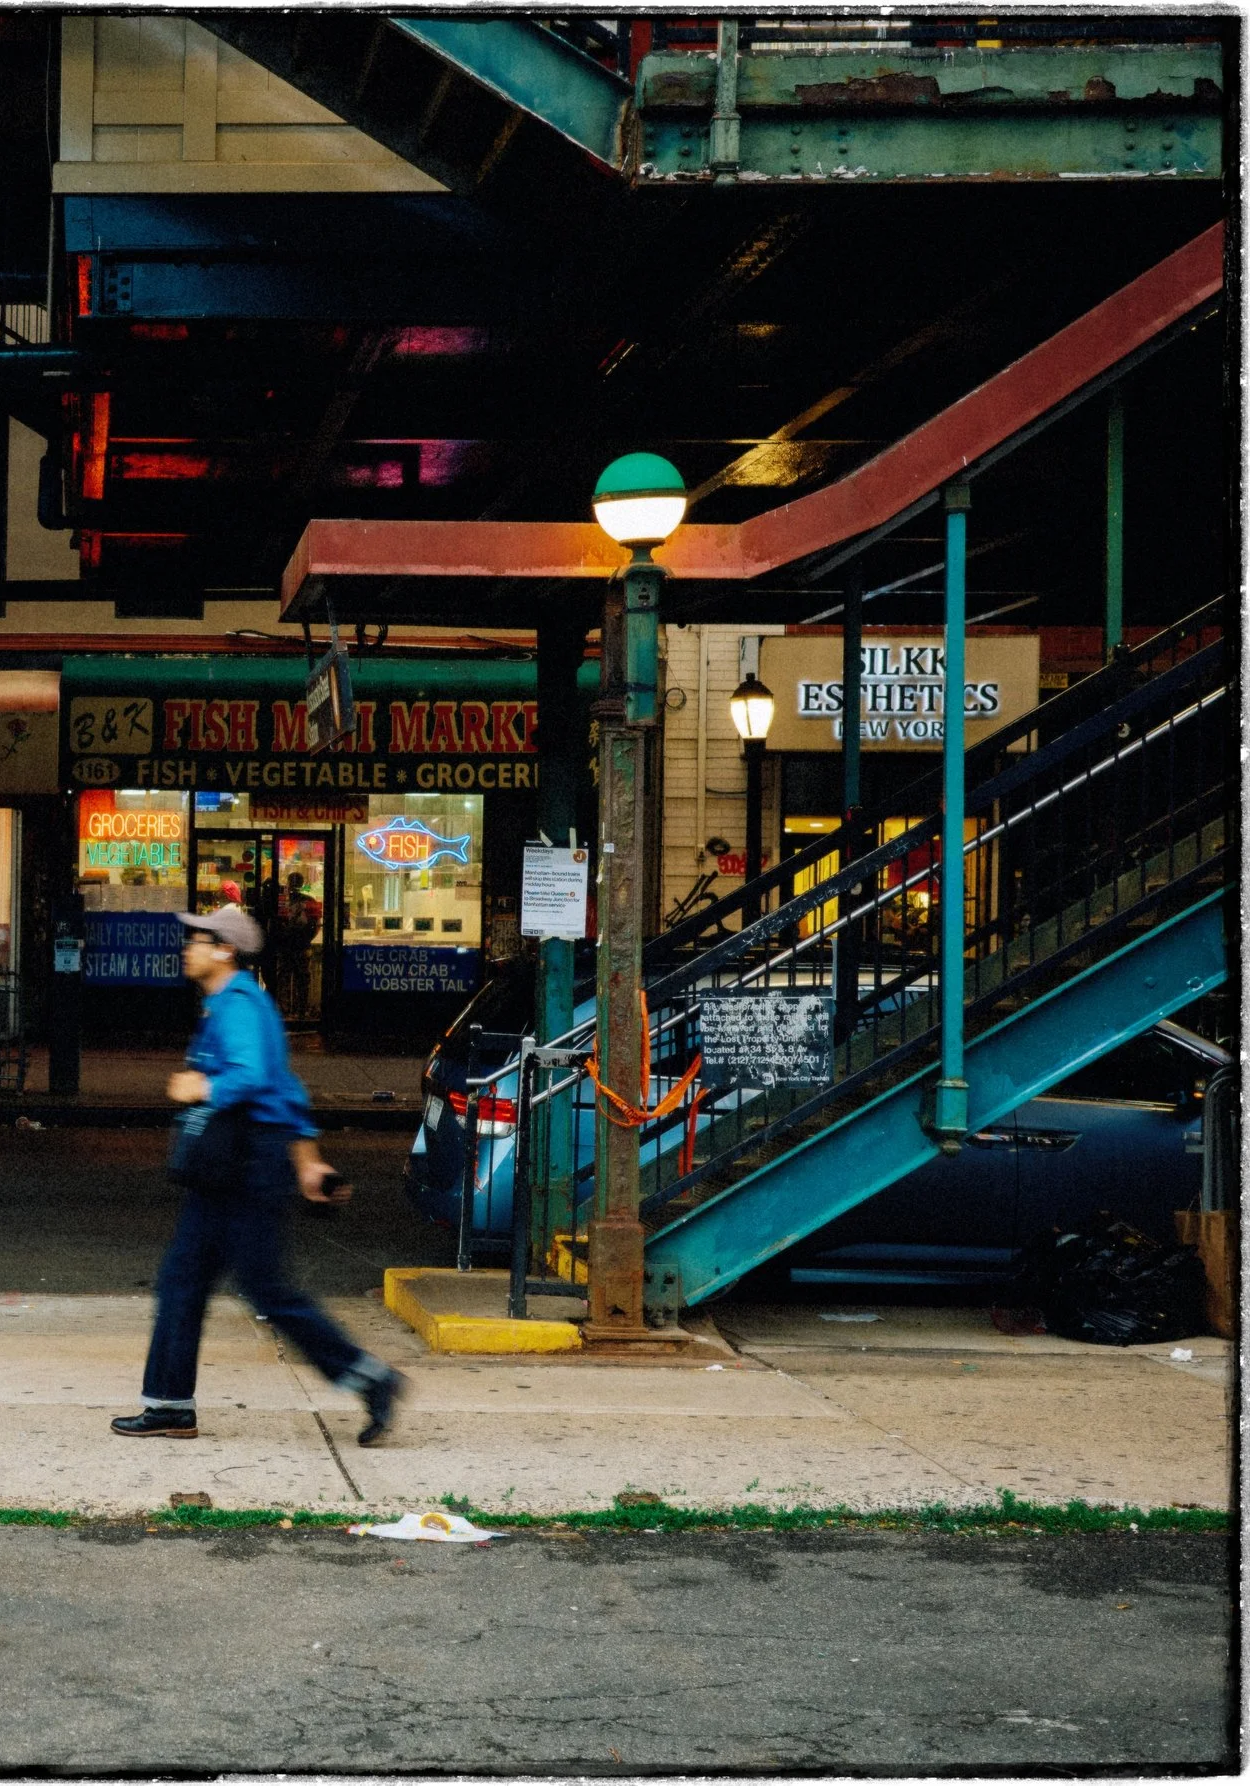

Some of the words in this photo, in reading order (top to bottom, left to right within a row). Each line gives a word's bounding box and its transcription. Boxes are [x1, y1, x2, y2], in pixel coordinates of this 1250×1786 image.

[801, 683, 999, 713] ESHETCS
[162, 699, 259, 752] FISH
[270, 699, 377, 753] MI
[137, 760, 199, 786] FISH
[224, 761, 387, 788] VEGETABLE
[89, 812, 181, 838] GROCERIES
[86, 841, 181, 867] VEGETABLE
[389, 834, 430, 859] FISH
[525, 847, 554, 855] Weekdays
[116, 921, 156, 948] FRESH
[85, 952, 128, 977] STEAM
[131, 953, 141, 977] &
[144, 953, 180, 978] FRIED
[354, 949, 388, 962] LIVE
[389, 950, 429, 962] CRAB
[363, 963, 406, 977] SNOW
[408, 963, 449, 977] CRAB
[372, 978, 434, 991] LOBSTER
[440, 979, 469, 991] TAIL
[703, 1046, 736, 1054] located
[751, 1046, 762, 1054] 34
[704, 1035, 718, 1043] the
[721, 1035, 739, 1043] Lost
